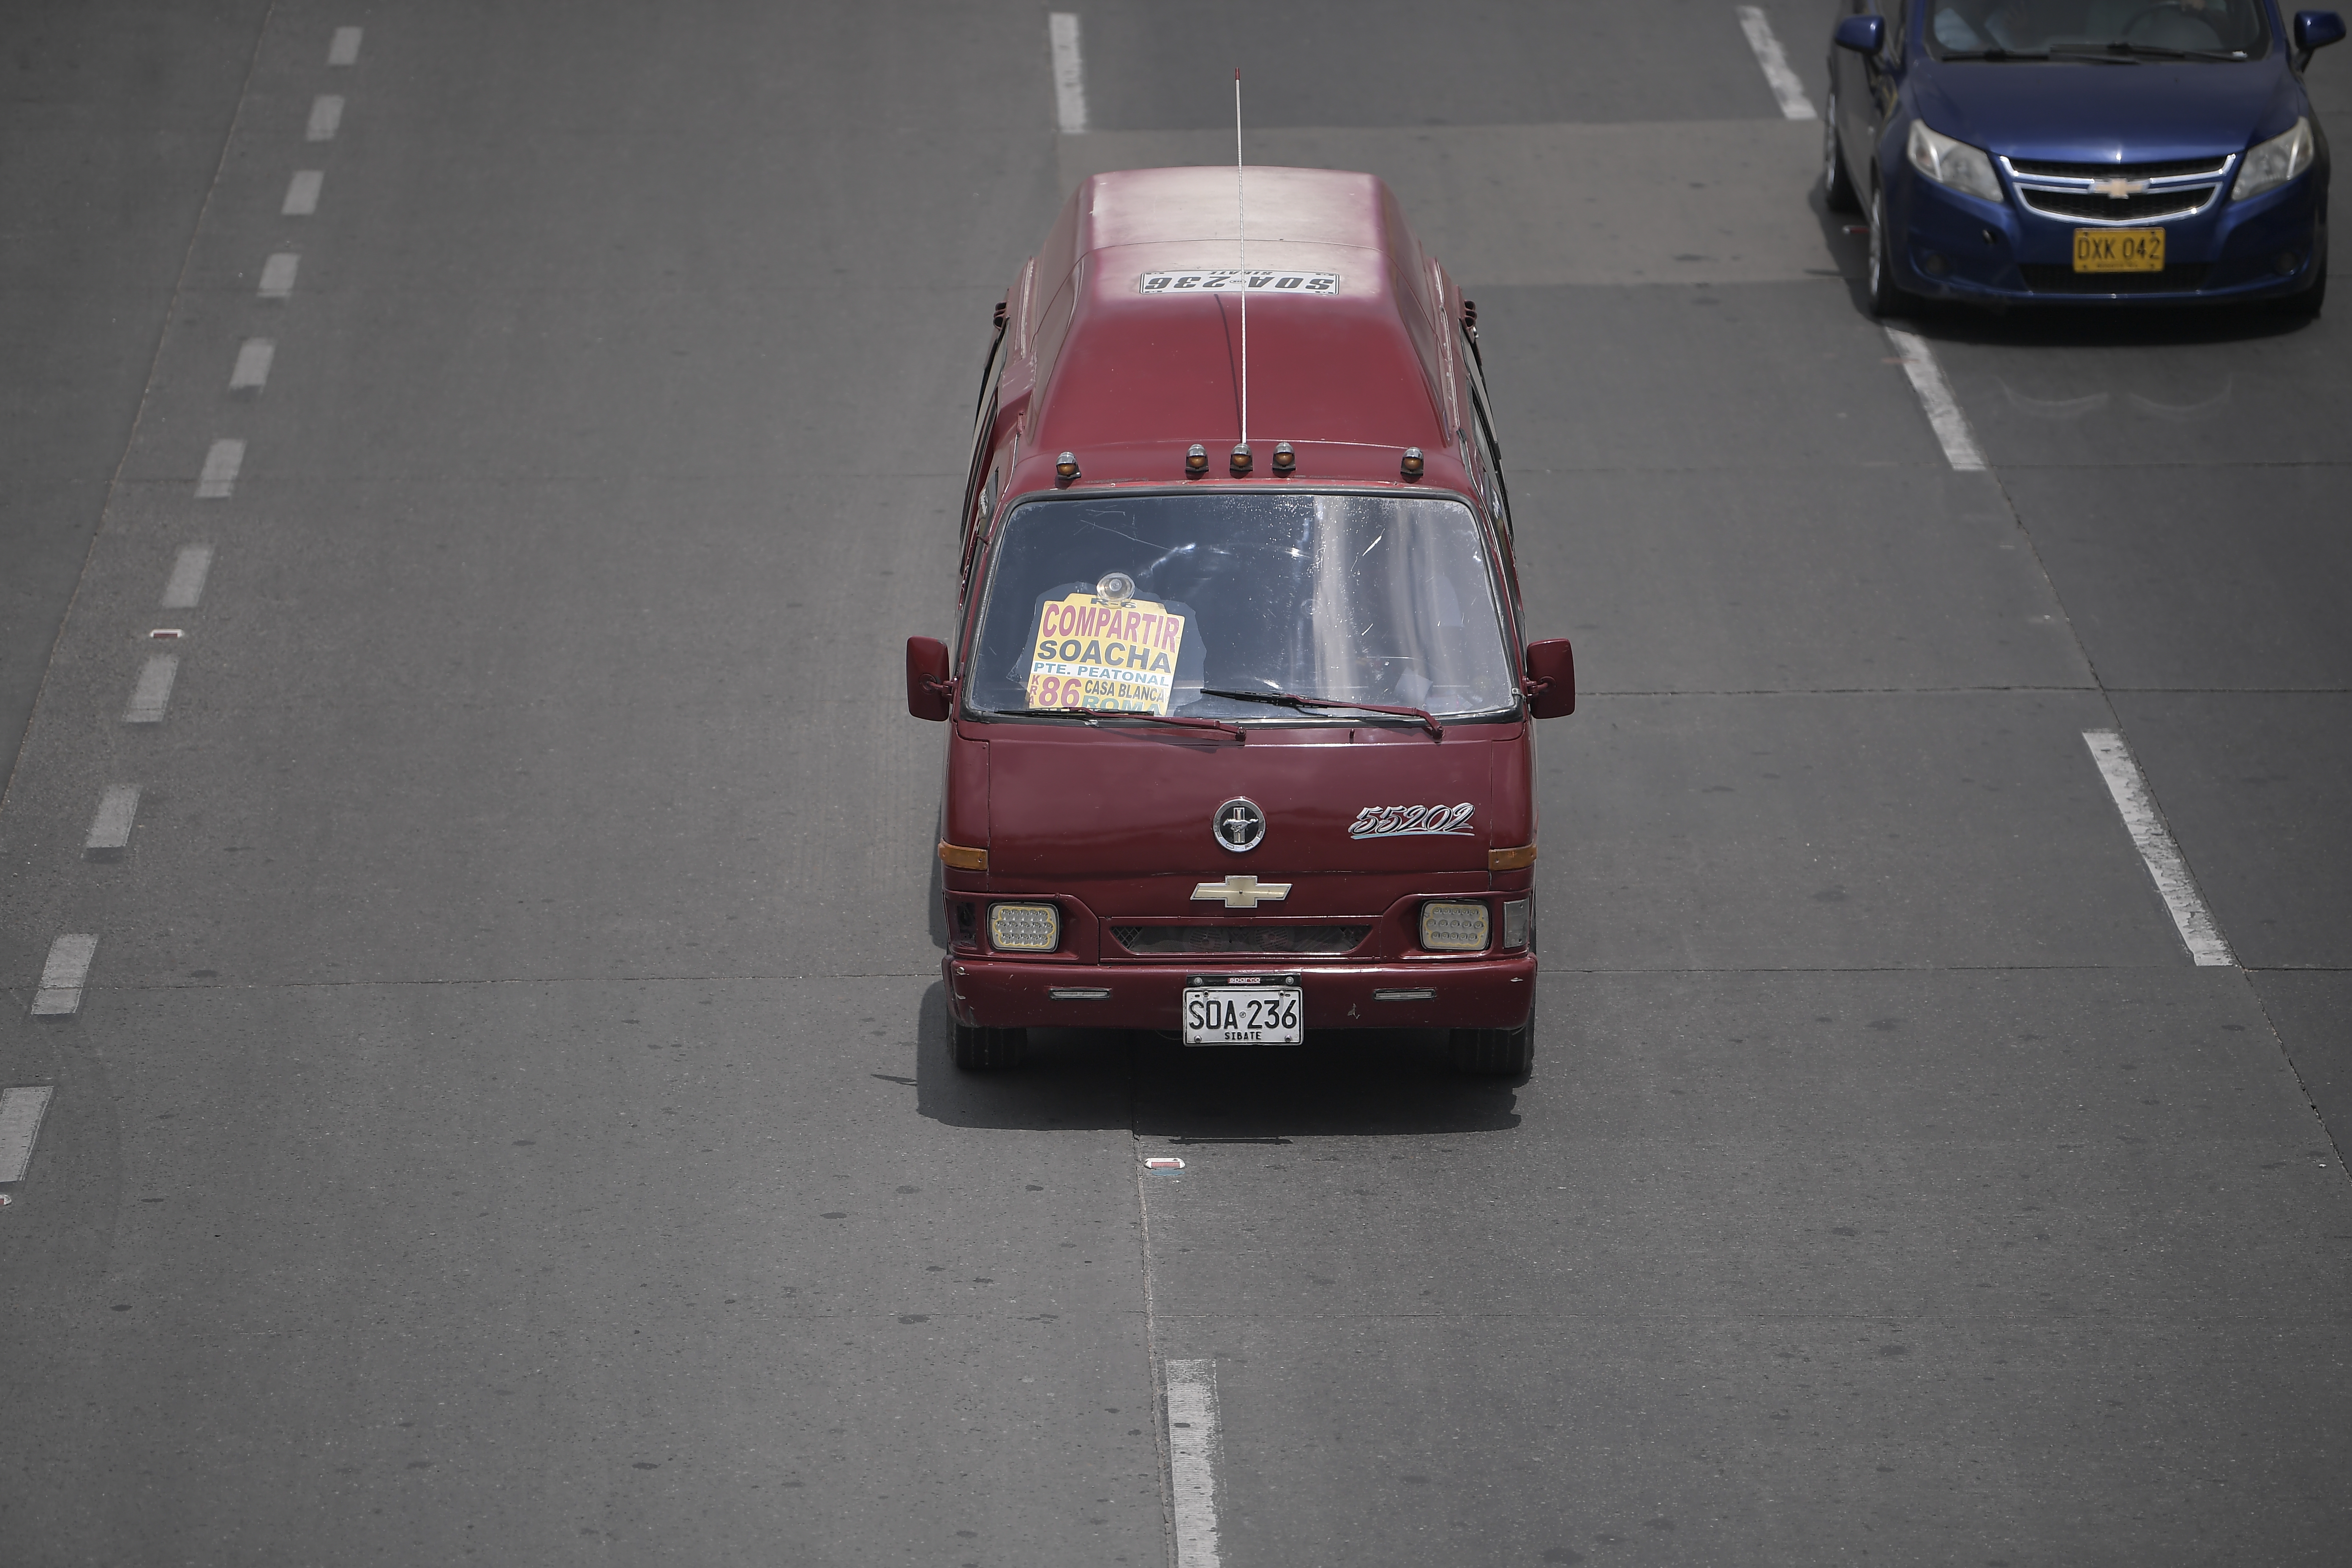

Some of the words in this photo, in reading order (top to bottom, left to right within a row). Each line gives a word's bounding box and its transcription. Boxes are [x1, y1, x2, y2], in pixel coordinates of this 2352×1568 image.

[2078, 237, 2116, 260] DXK
[2123, 237, 2161, 260] 042
[1043, 604, 1180, 653] COMPARTIR
[1037, 640, 1171, 673] SOACHA
[1033, 662, 1071, 675] PTE.
[1078, 666, 1169, 686] PEATONAL
[1038, 676, 1082, 707] 86
[1084, 680, 1114, 695] CASA
[1119, 683, 1165, 703] BLANCA
[1348, 802, 1475, 835] 55202
[1247, 999, 1297, 1029] 236
[1225, 1031, 1262, 1040] SIBATE
